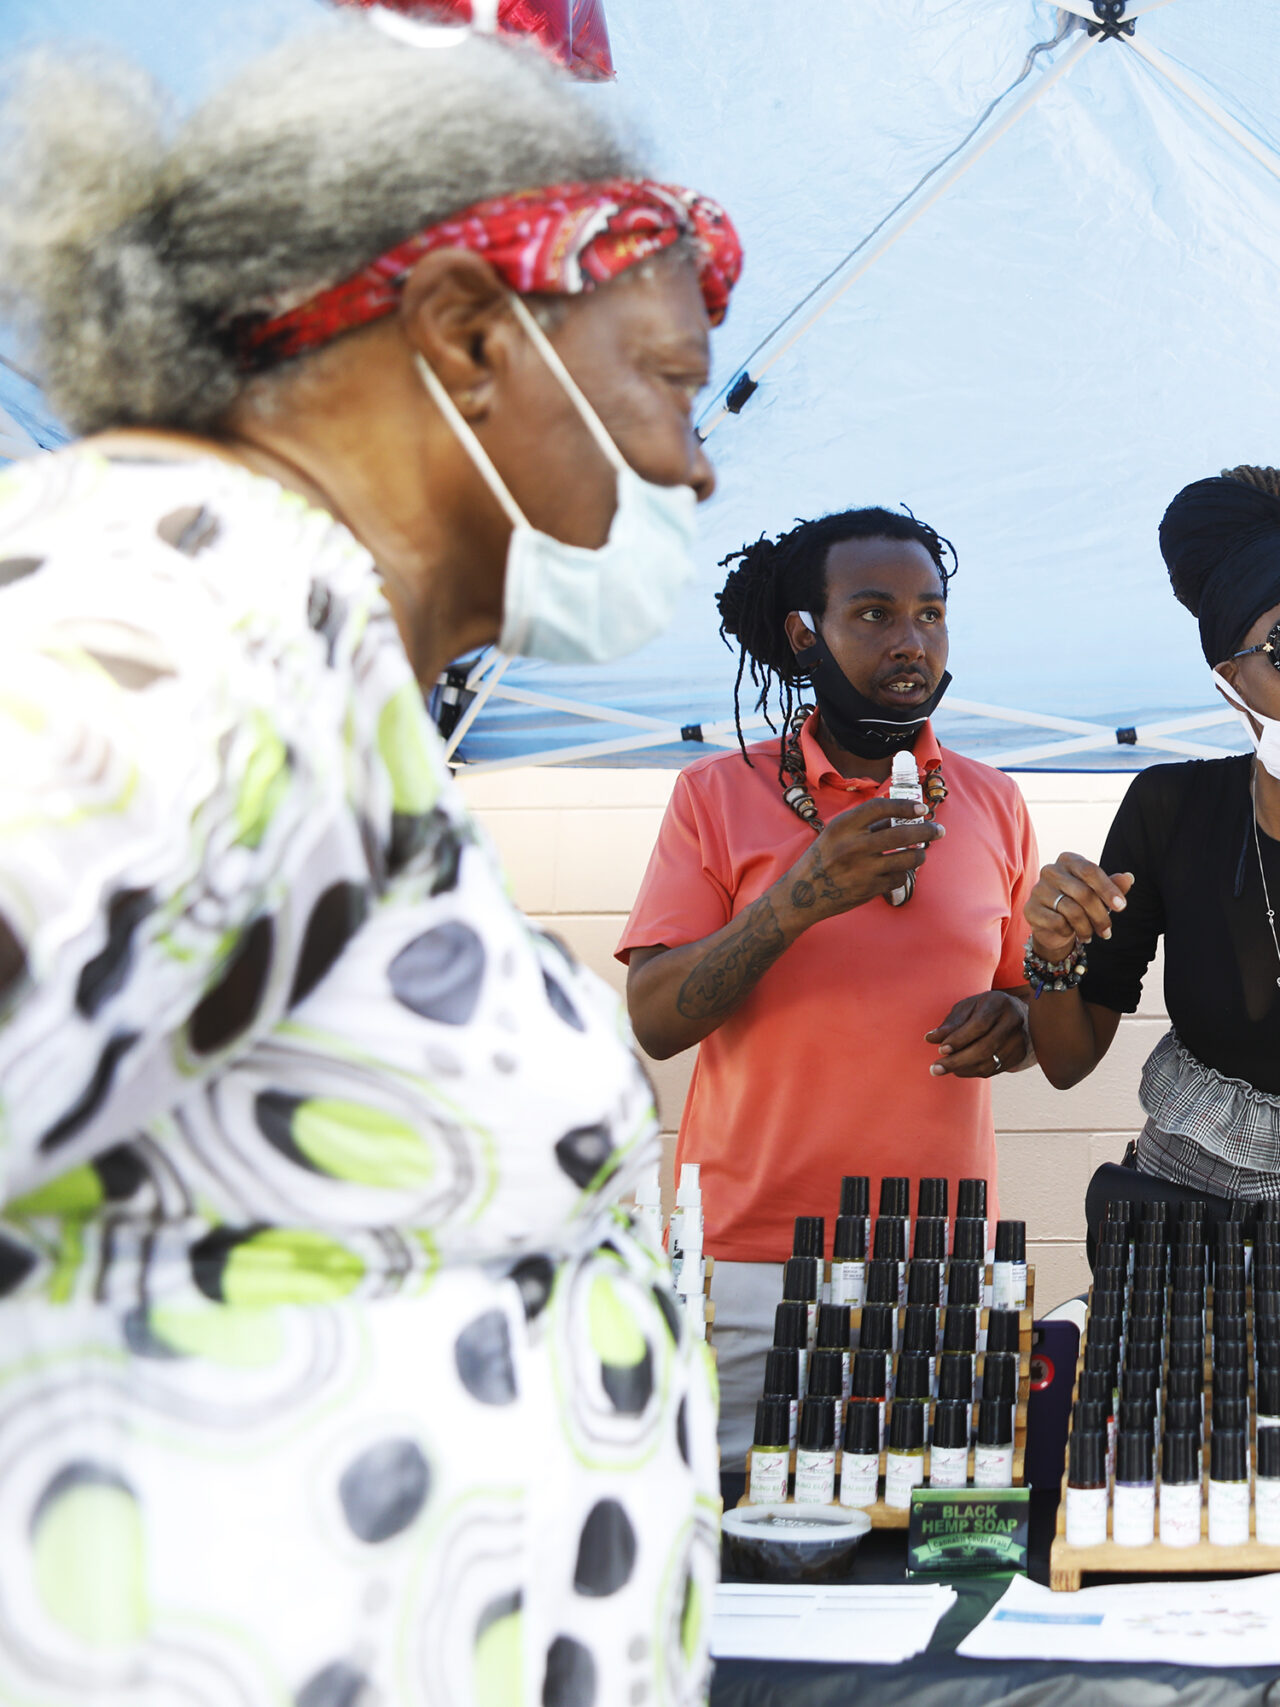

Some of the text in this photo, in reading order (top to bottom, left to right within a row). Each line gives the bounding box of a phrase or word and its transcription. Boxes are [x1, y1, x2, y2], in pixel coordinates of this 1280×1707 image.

[942, 1504, 998, 1518] BLACK
[922, 1518, 1018, 1533] HEMP SOAP
